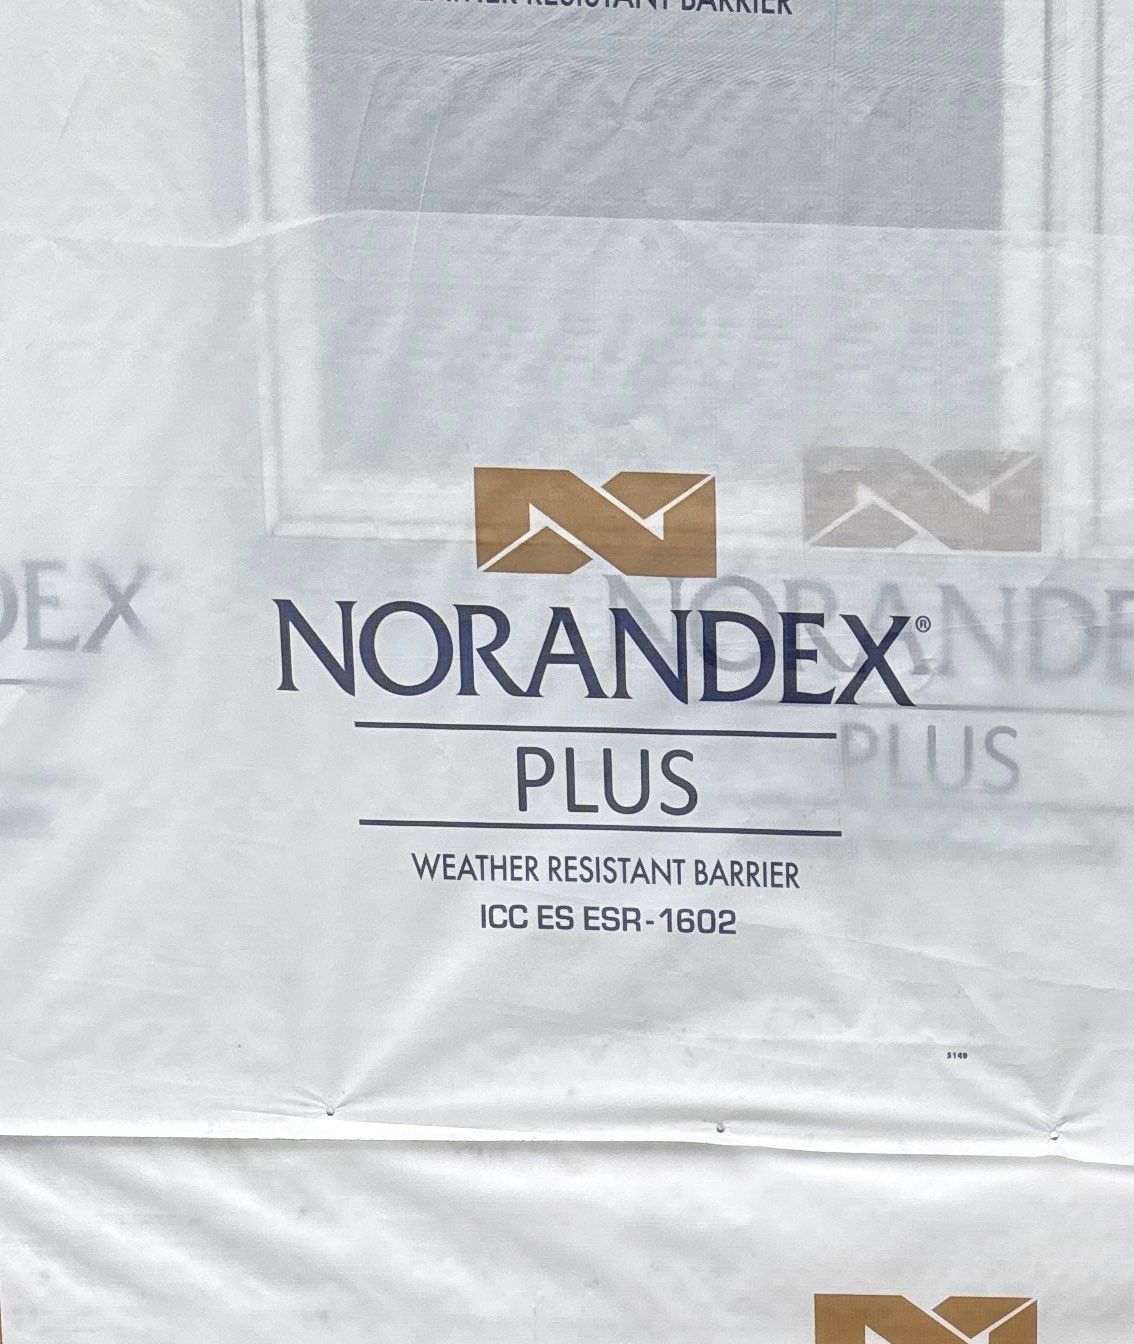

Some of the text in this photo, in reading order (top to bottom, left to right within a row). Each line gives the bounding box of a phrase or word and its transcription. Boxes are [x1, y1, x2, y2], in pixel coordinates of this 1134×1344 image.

[275, 598, 932, 706] NORANDEX®
[515, 745, 699, 817] PLUS
[410, 852, 801, 890] WEATHER RESISTANT BARRIER
[480, 903, 738, 935] ICC ES ESR-1602
